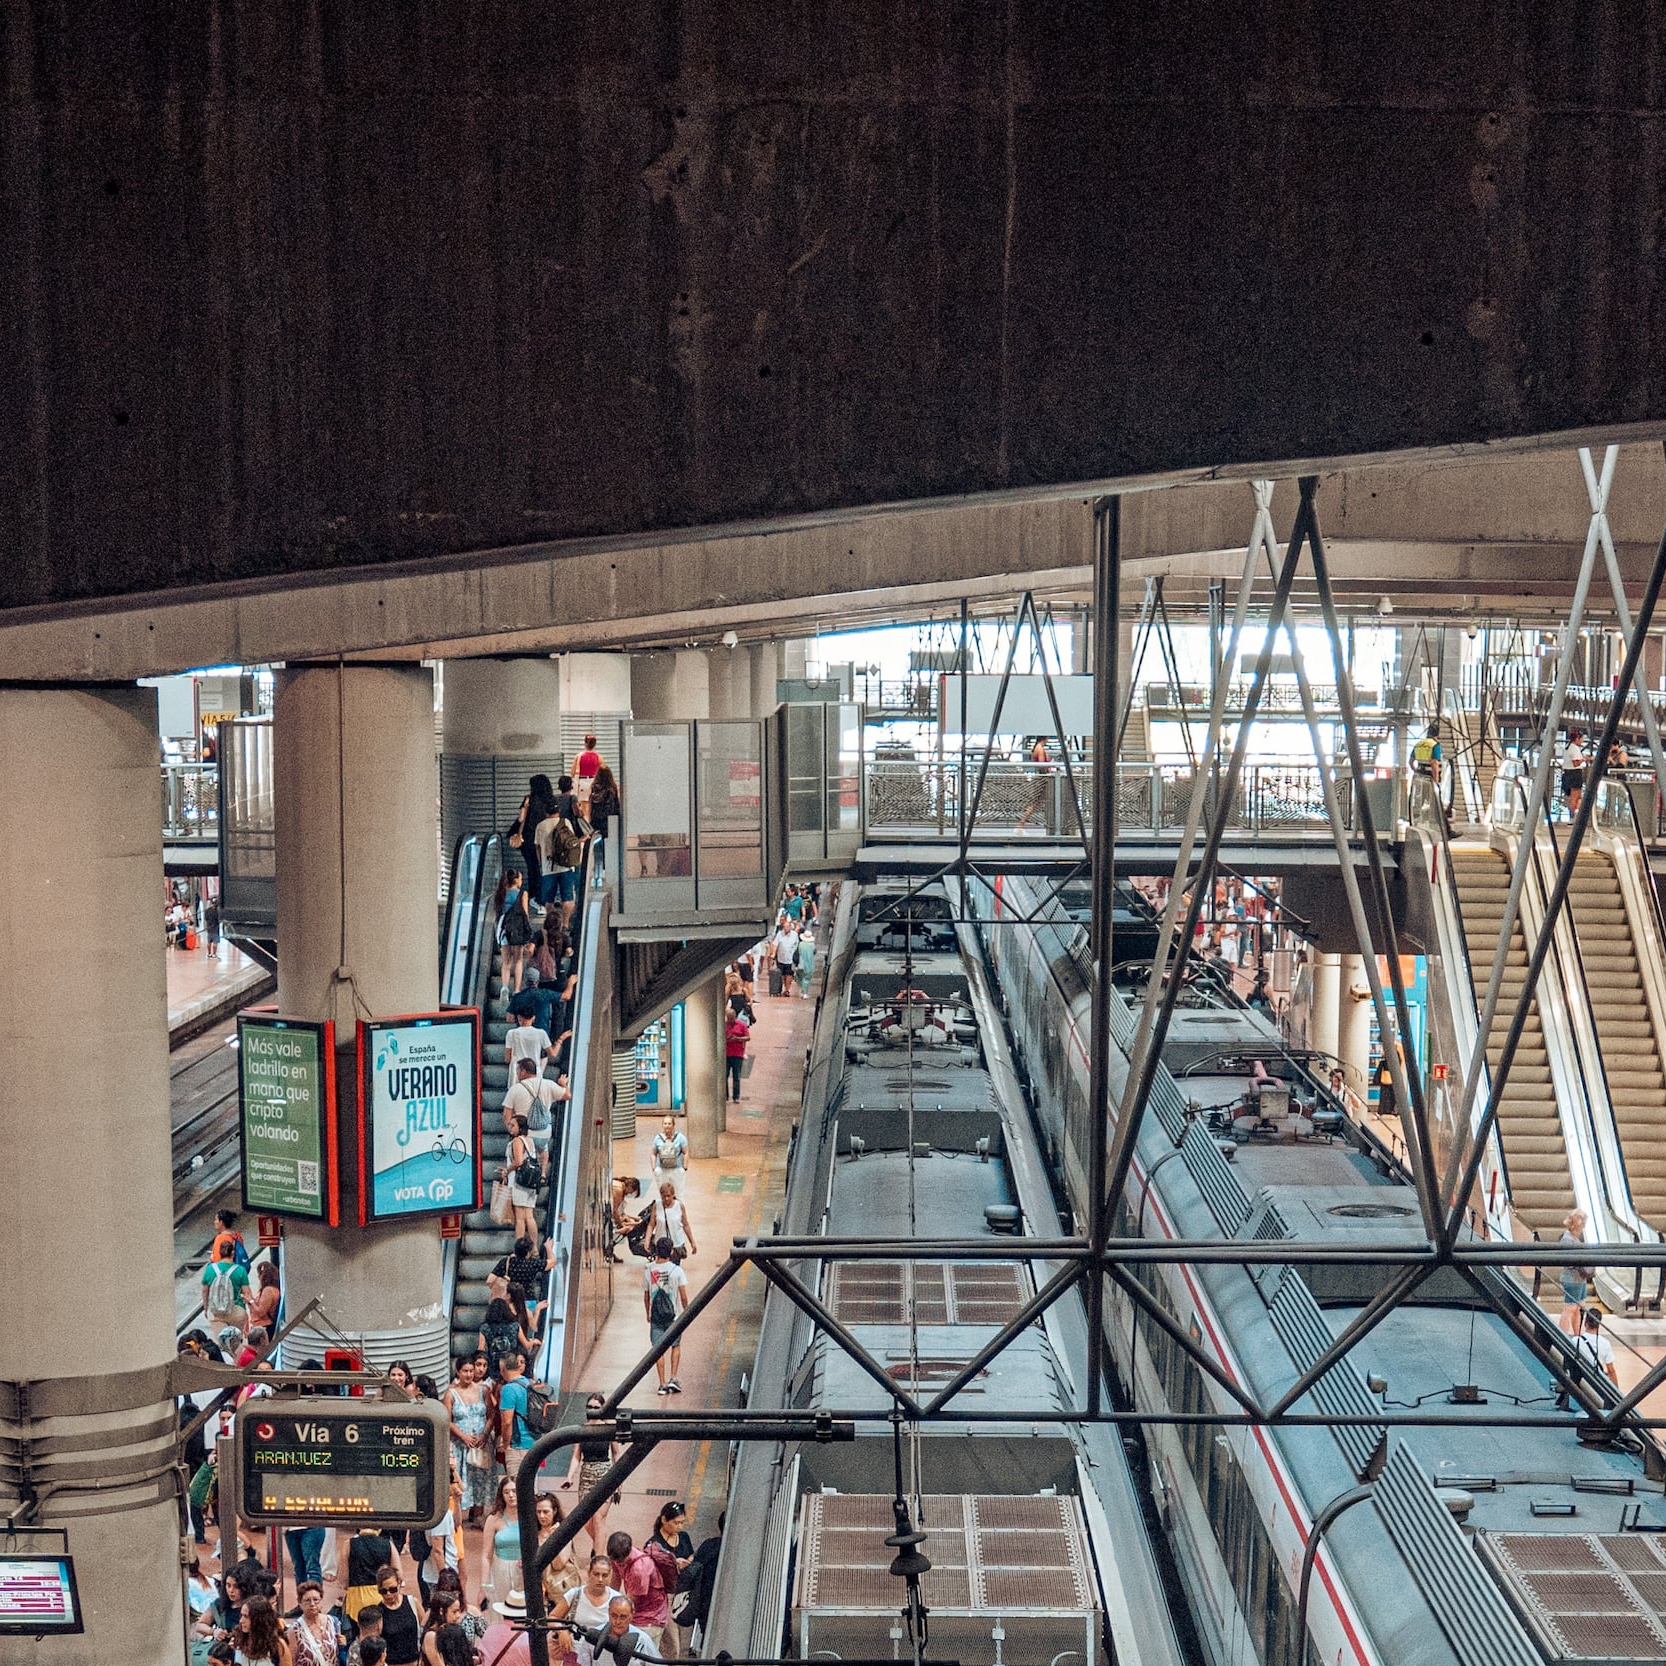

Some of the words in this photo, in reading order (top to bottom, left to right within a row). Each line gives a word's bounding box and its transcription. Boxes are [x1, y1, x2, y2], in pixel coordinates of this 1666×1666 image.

[248, 1037, 274, 1055] Más
[275, 1040, 302, 1058] vale
[409, 1045, 436, 1055] España
[399, 1056, 408, 1064] se
[409, 1055, 436, 1063] merece
[437, 1053, 446, 1061] un
[248, 1060, 289, 1079] ladrillo
[291, 1066, 307, 1080] en
[388, 1063, 457, 1101] VERANO
[249, 1083, 284, 1099] mano
[286, 1086, 310, 1104] que
[250, 1101, 284, 1121] cripto
[396, 1098, 451, 1147] AZUL
[250, 1123, 299, 1142] volando
[394, 1186, 425, 1201] VOTA
[295, 1423, 330, 1443] Vía
[345, 1424, 360, 1443] 6
[383, 1425, 425, 1438] Próximo
[393, 1437, 415, 1446] tren
[254, 1452, 332, 1466] ARANJUEZ
[381, 1453, 420, 1468] 10:58
